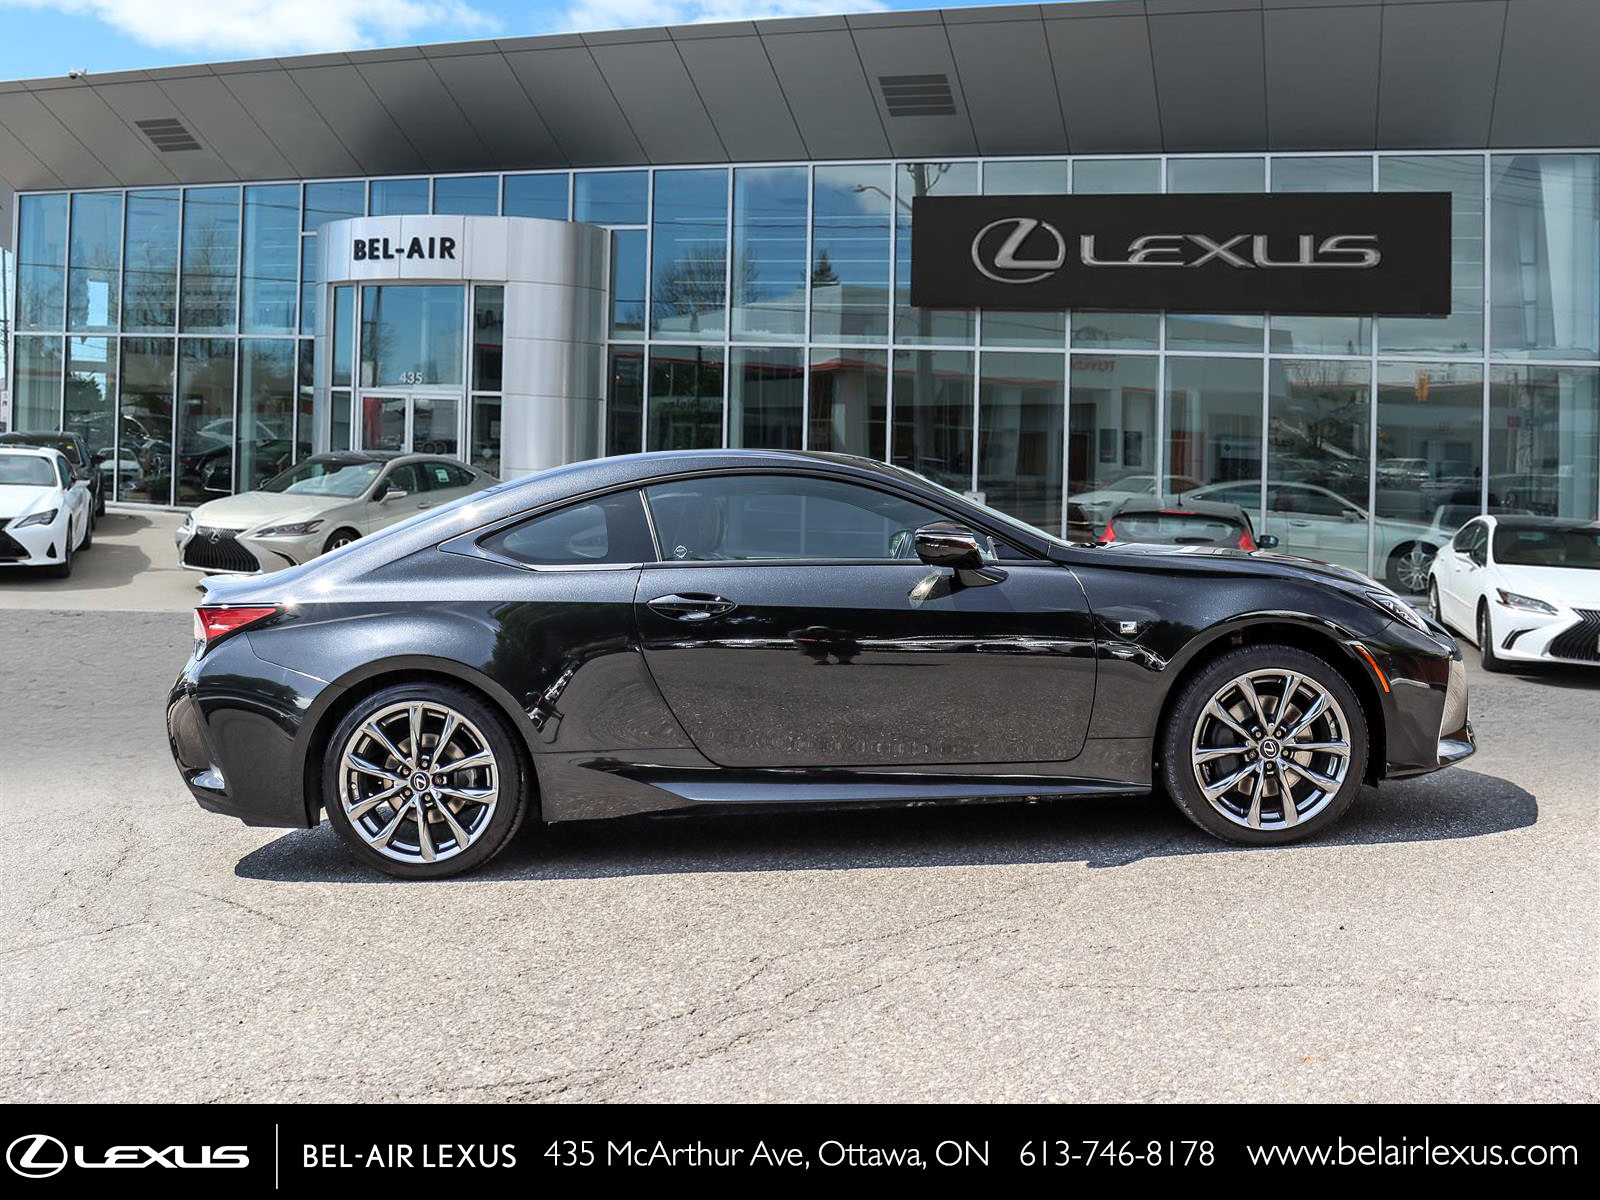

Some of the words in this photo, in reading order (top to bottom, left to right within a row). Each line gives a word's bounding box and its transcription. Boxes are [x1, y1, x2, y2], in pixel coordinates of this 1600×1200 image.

[353, 237, 457, 261] BEL-AIR
[1080, 233, 1382, 269] LEXUS
[398, 370, 424, 385] 435
